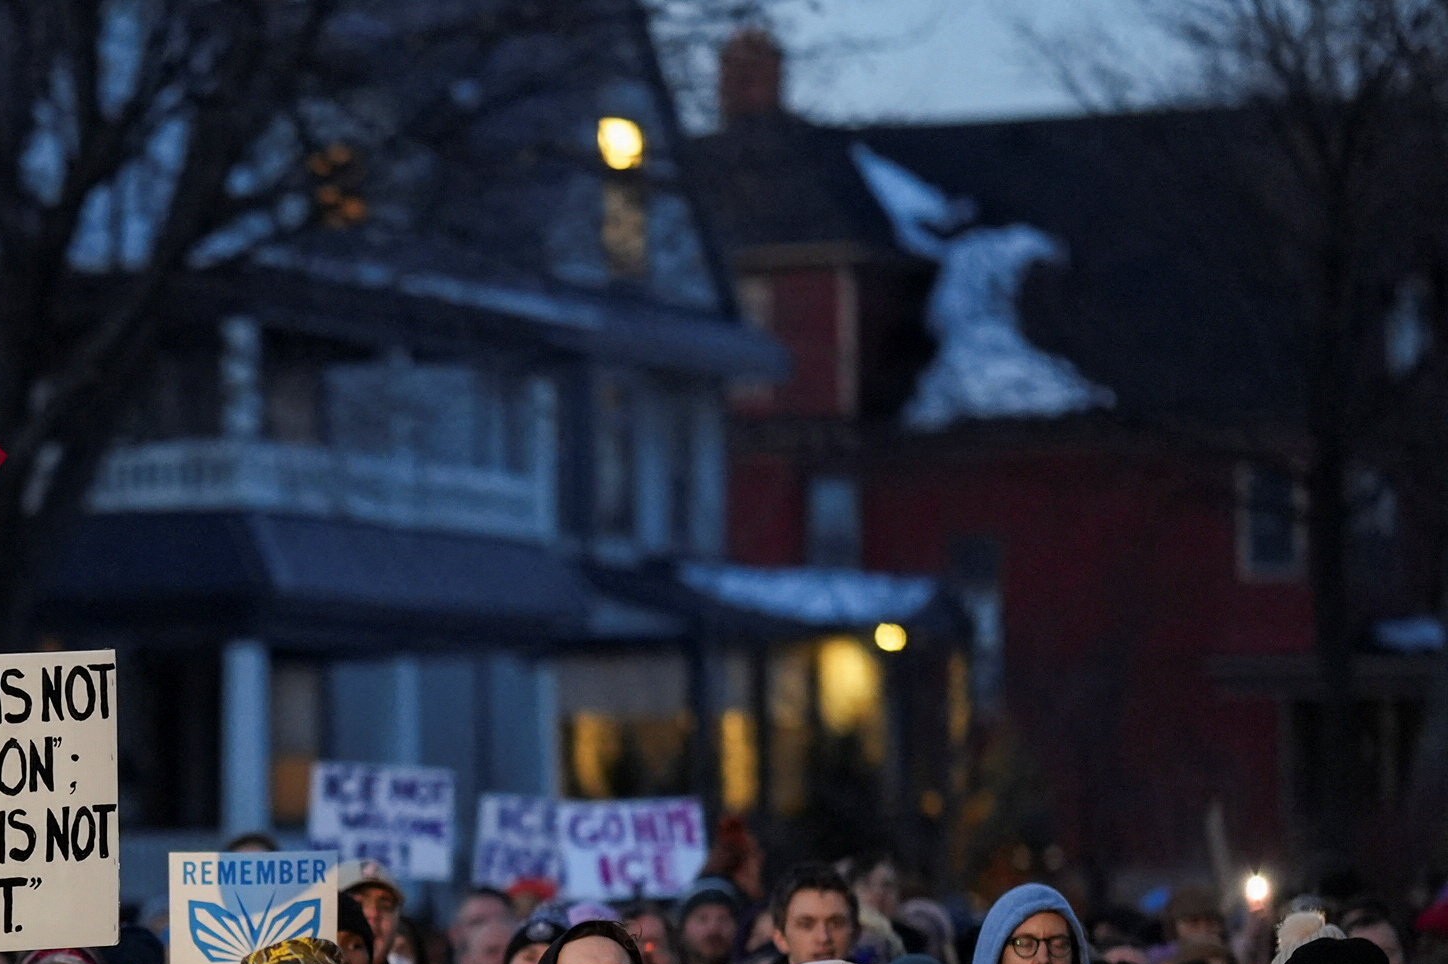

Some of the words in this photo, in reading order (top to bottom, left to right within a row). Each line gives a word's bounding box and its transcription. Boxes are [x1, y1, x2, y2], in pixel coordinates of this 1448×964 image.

[41, 663, 115, 723] NOT
[0, 808, 36, 864] IS
[46, 804, 116, 862] NOT
[568, 812, 626, 849] GO
[183, 860, 326, 886] REMEMBER
[598, 851, 680, 890] ICE
